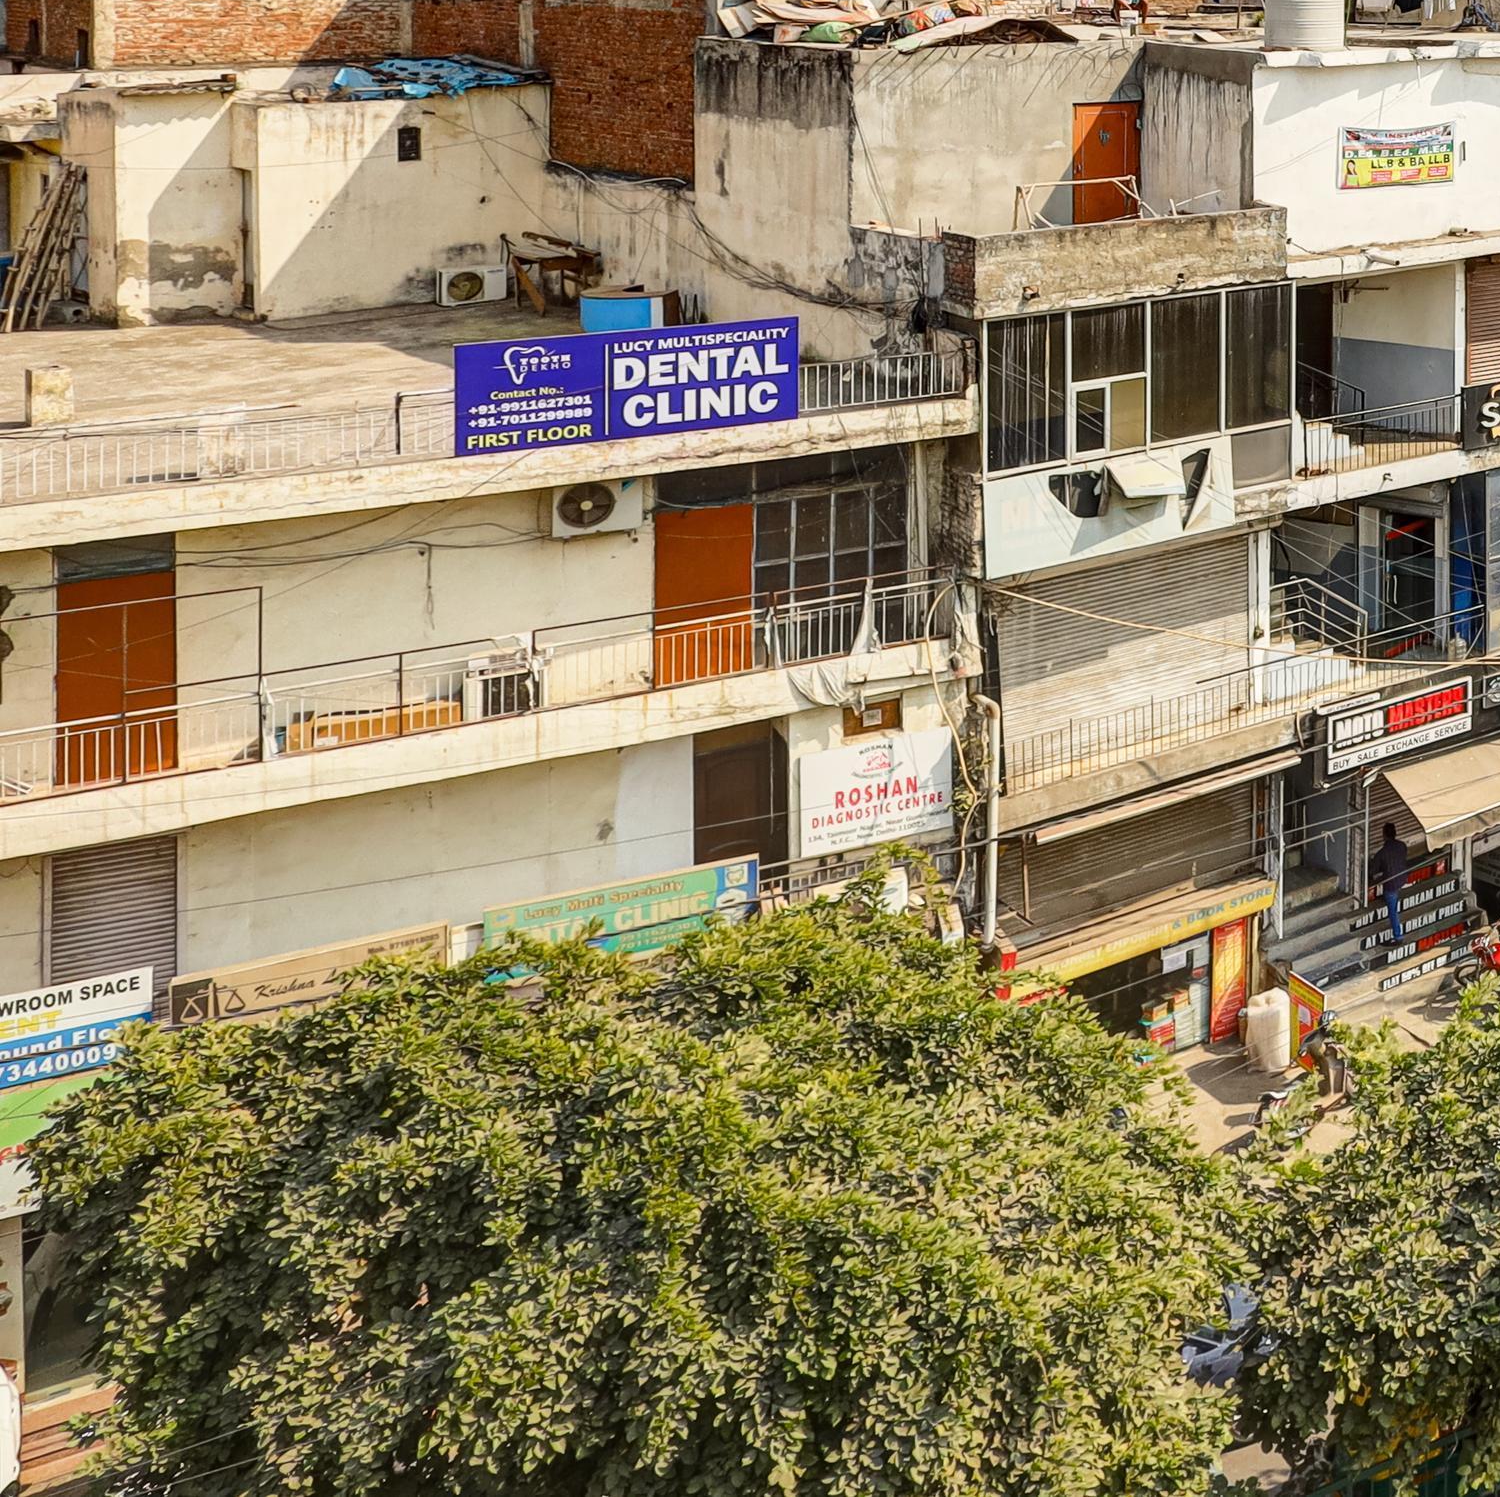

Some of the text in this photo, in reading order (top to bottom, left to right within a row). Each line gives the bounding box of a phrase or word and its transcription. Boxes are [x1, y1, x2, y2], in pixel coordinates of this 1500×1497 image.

[1410, 157, 1425, 166] BA
[613, 327, 789, 354] LUCY MULTISPECIALITY
[519, 362, 571, 374] DEKHO
[613, 343, 789, 391] DENTAL
[490, 387, 535, 401] Contact
[622, 381, 779, 428] CLINIC
[466, 424, 592, 450] FIRST FLOOR
[859, 744, 893, 756] ROSHAN
[1332, 721, 1468, 771] BUY SALE EXCHANGE SERVICE
[834, 775, 918, 809] ROSHAN
[812, 791, 943, 829] DIAGNOSTIC CENTRE
[524, 879, 685, 922] Lucy Multi Speciality
[614, 891, 710, 931] CLINIC
[1172, 918, 1182, 930] &
[1187, 905, 1225, 924] BOOK
[1229, 886, 1273, 909] STORE
[1355, 911, 1374, 929] BUY
[1403, 889, 1434, 911] DREAM
[1436, 880, 1456, 897] BIKE
[1365, 934, 1377, 950] AT
[1405, 910, 1437, 937] DREAM
[1438, 899, 1464, 922] PRICE
[1387, 942, 1416, 964] MOTO
[80, 976, 141, 1001] SPACE
[254, 977, 316, 1001] Krishna
[1383, 975, 1400, 991] FLAT
